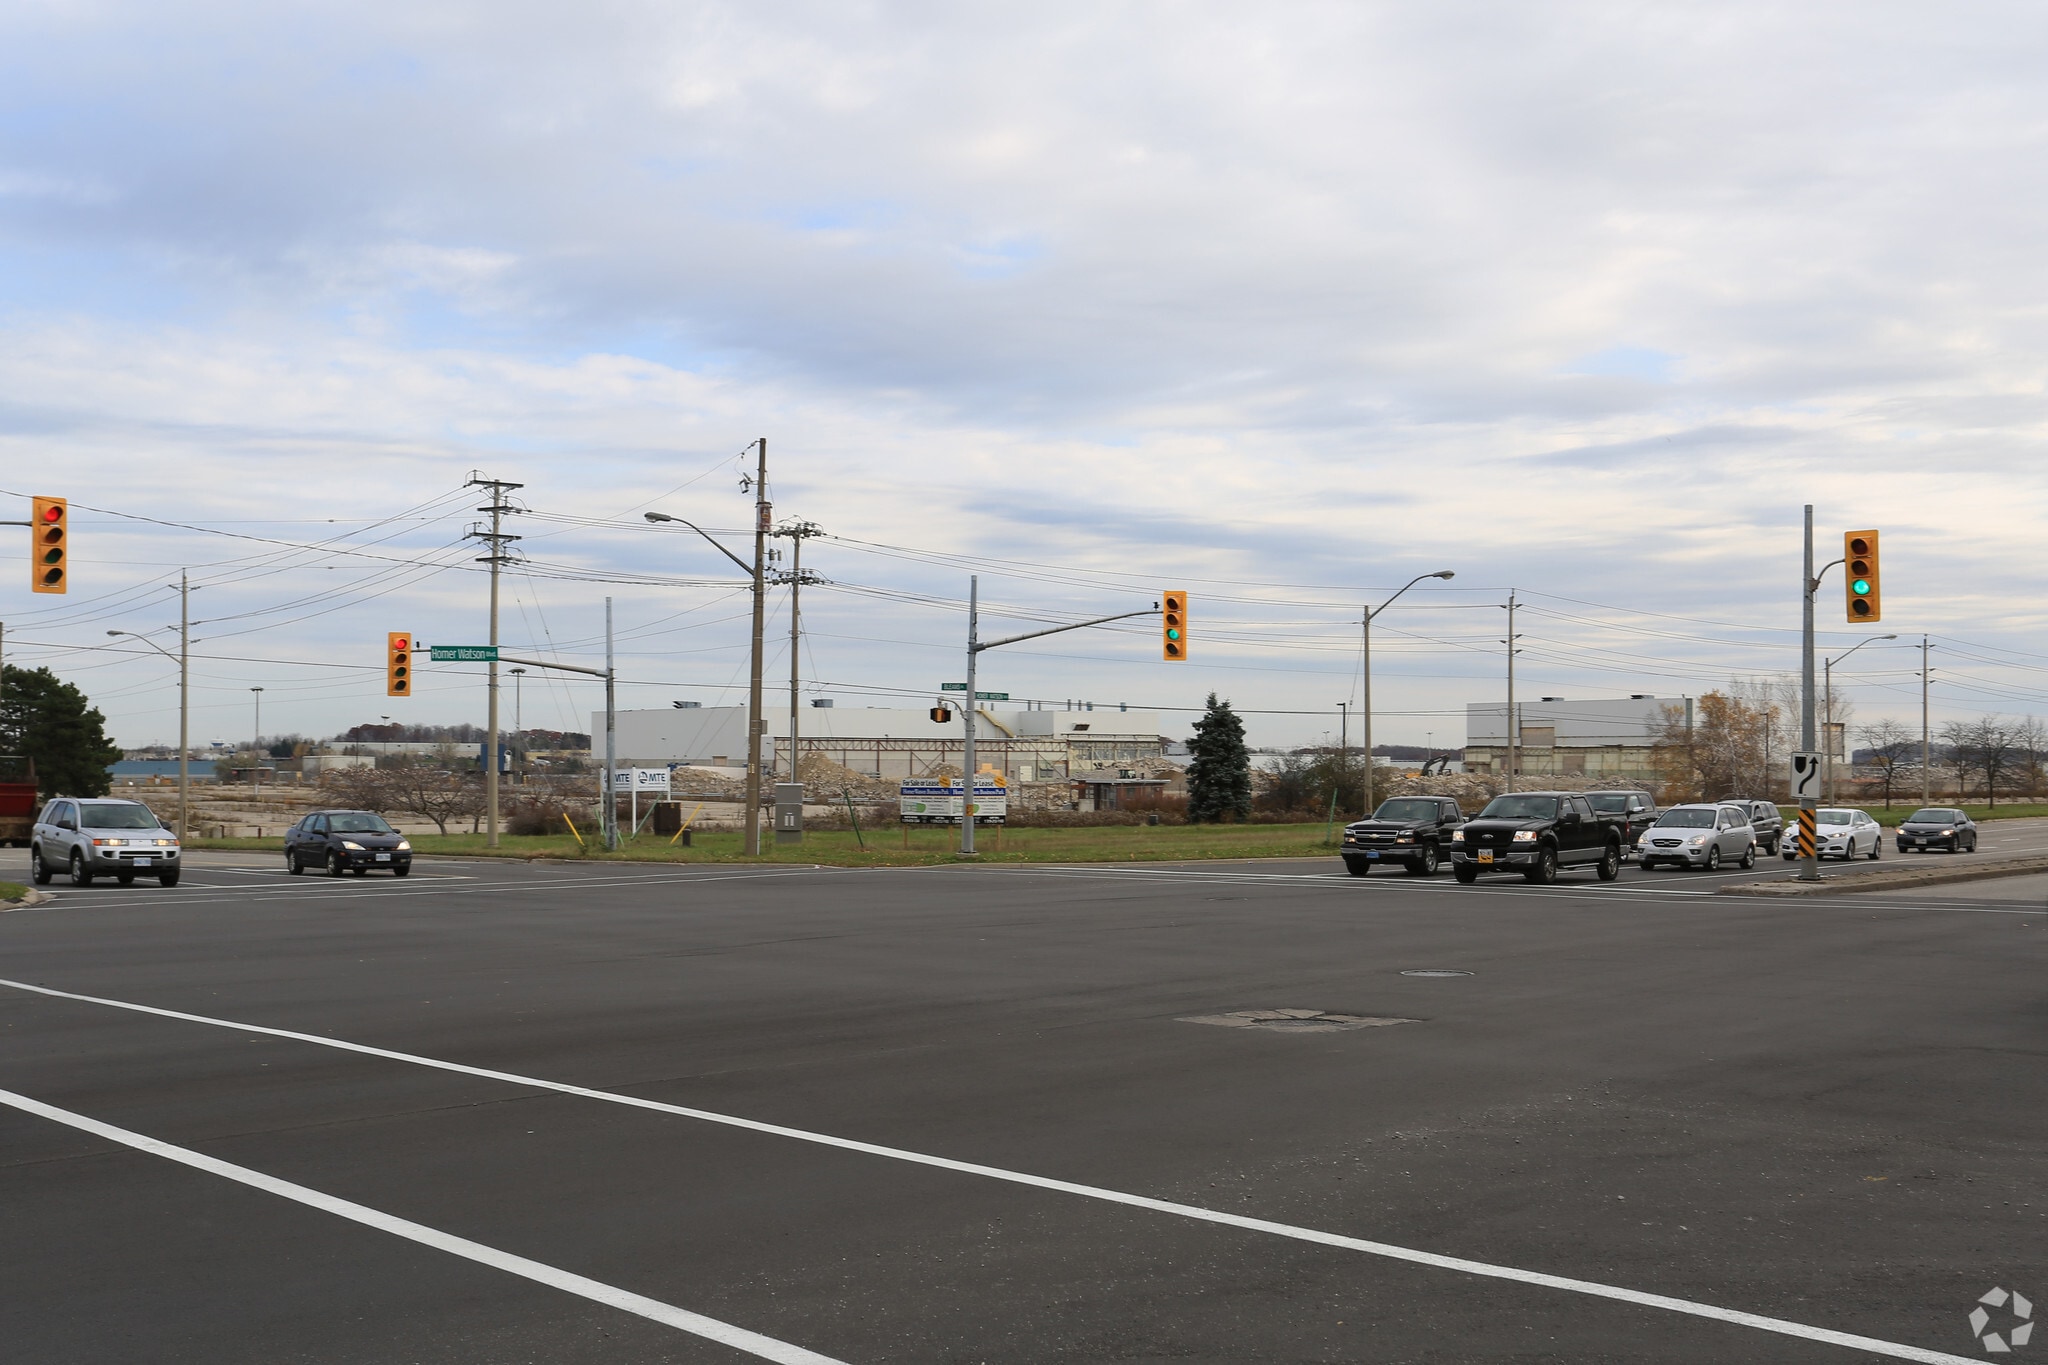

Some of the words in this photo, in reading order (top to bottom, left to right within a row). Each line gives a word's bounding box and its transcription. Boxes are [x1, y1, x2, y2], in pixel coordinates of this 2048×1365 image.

[431, 648, 457, 659] Homer
[457, 648, 486, 659] Watson
[649, 773, 666, 782] MTE
[911, 779, 920, 787] Sale
[926, 779, 939, 787] Lease
